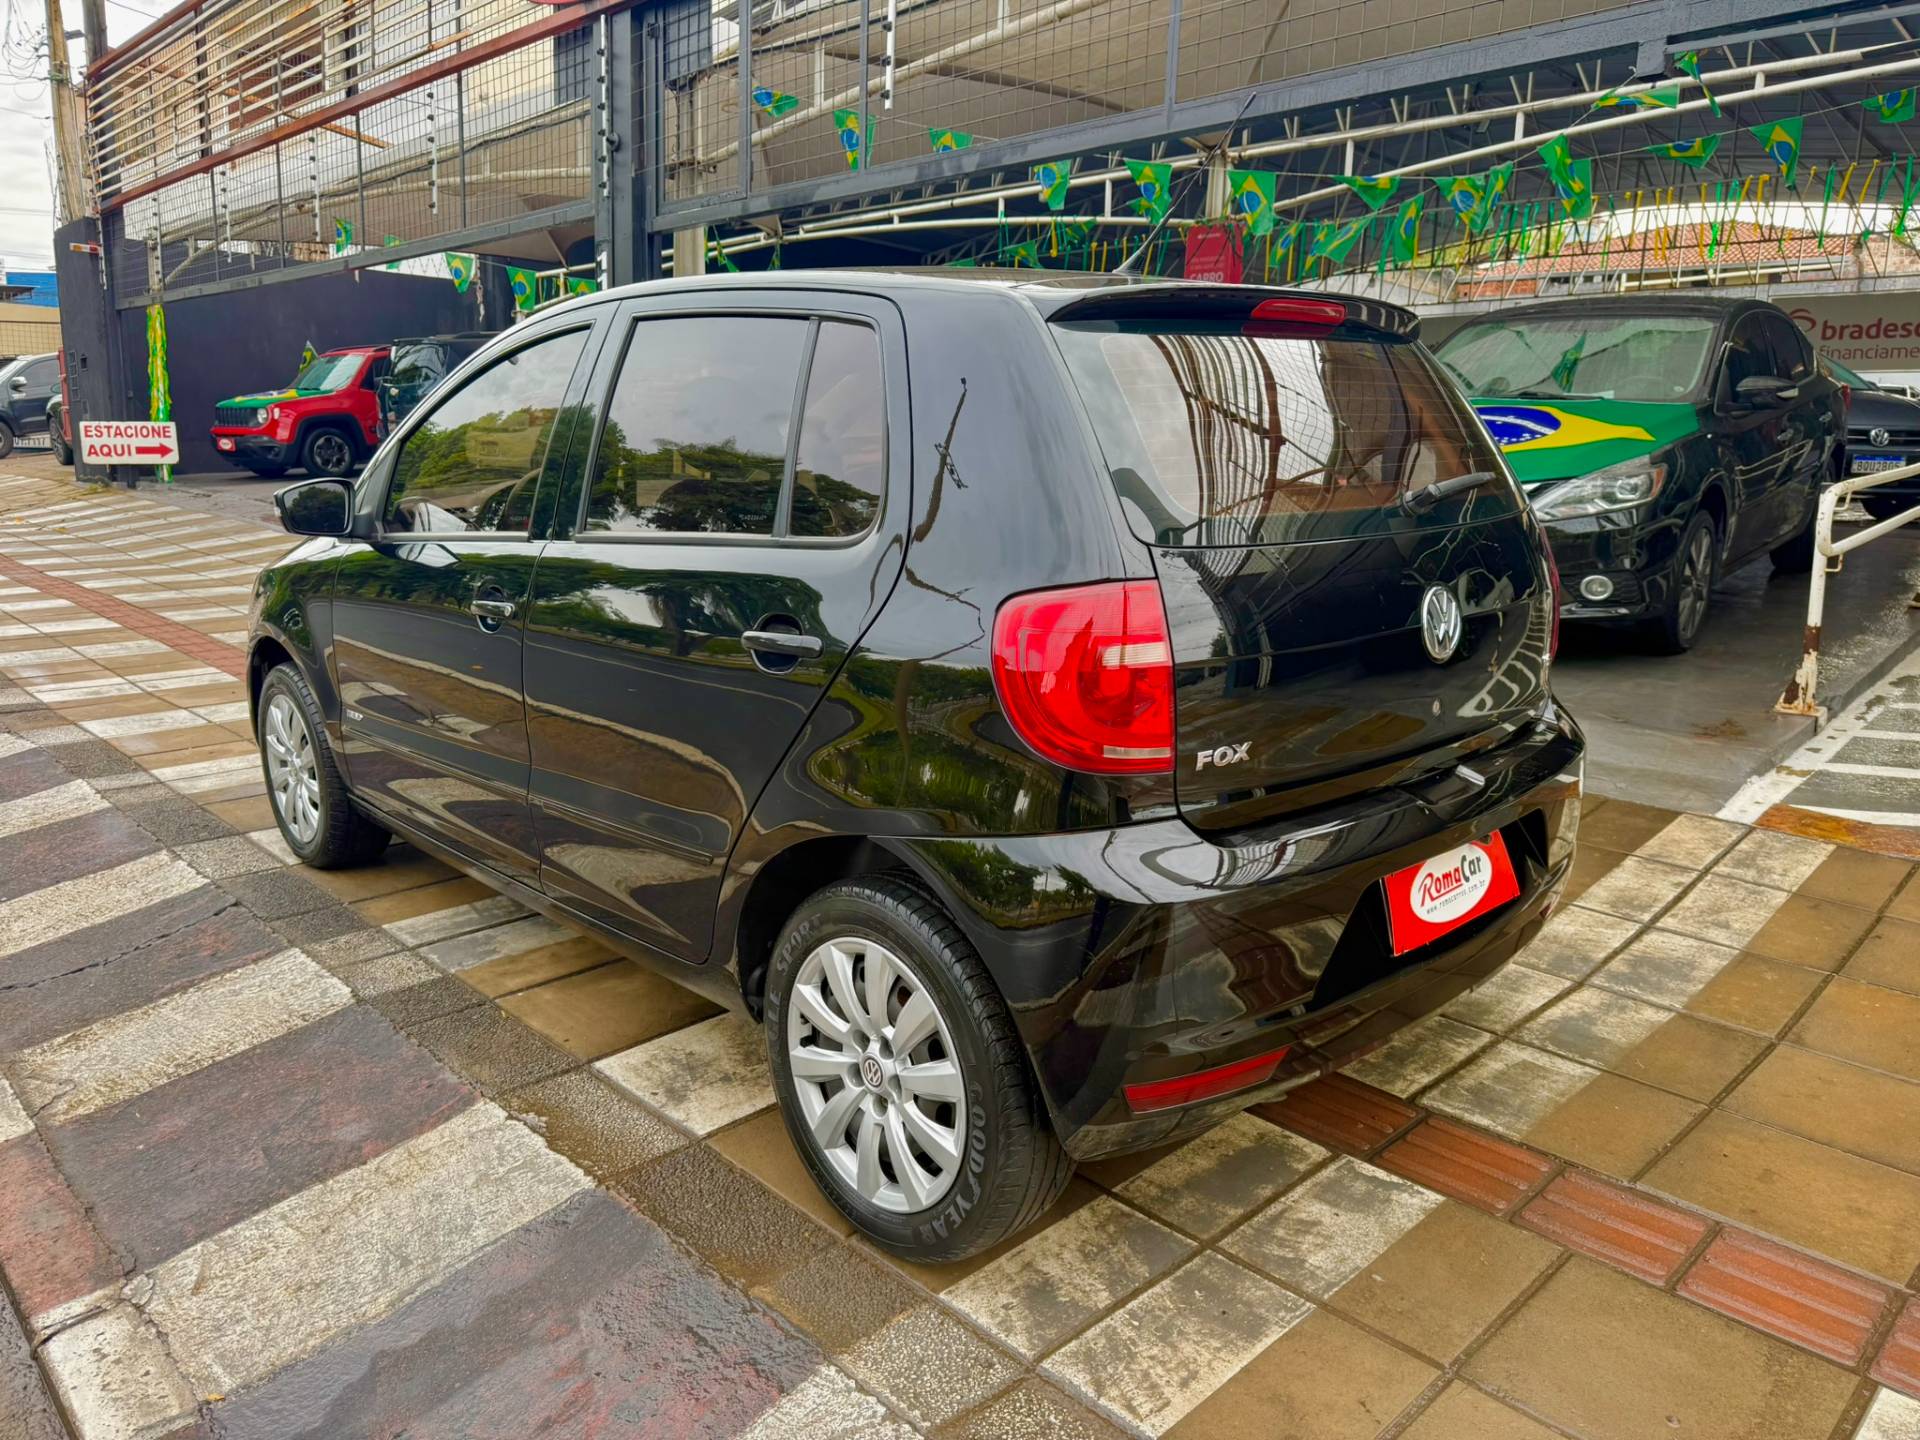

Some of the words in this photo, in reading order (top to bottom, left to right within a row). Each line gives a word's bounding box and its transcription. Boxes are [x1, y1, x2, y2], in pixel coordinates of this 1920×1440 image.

[84, 425, 172, 438] ESTACIONE
[87, 444, 132, 458] AQUI
[1195, 741, 1253, 771] FOX
[918, 1080, 987, 1244] GOODYEAR
